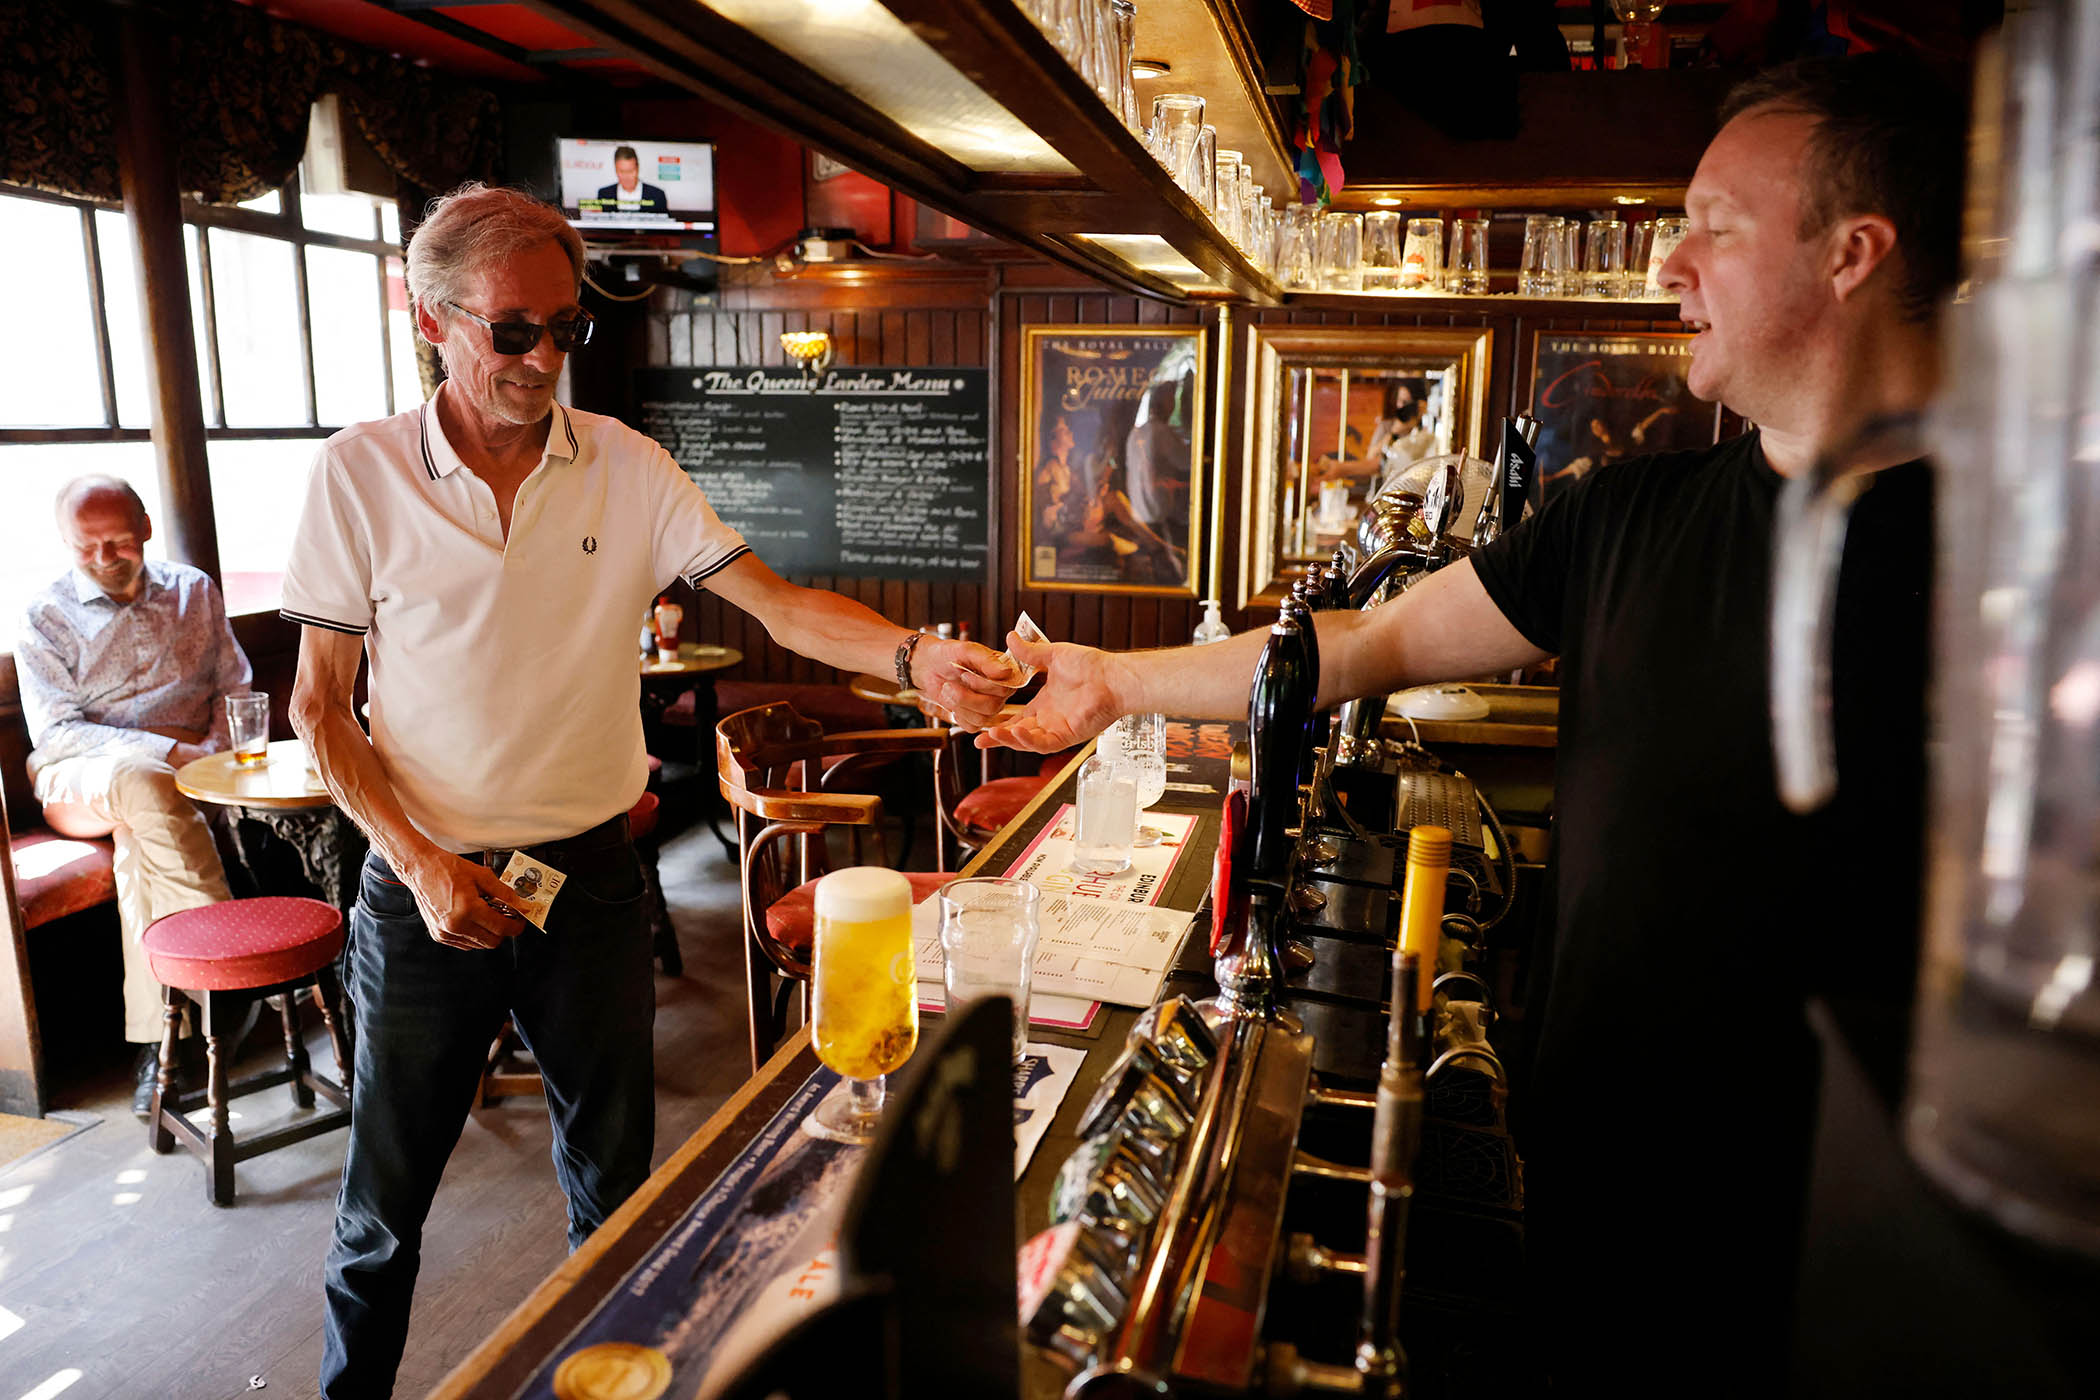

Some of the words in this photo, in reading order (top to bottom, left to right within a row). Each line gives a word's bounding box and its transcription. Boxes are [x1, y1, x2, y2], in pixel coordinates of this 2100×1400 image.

[1079, 341, 1124, 350] ROYAL
[1648, 344, 1693, 357] BALL
[704, 371, 743, 391] The
[824, 371, 886, 391] Larder
[888, 371, 950, 391] Menu
[1509, 453, 1525, 488] Asahi
[1127, 874, 1157, 904] EDINBUR
[788, 1259, 833, 1300] ALE
